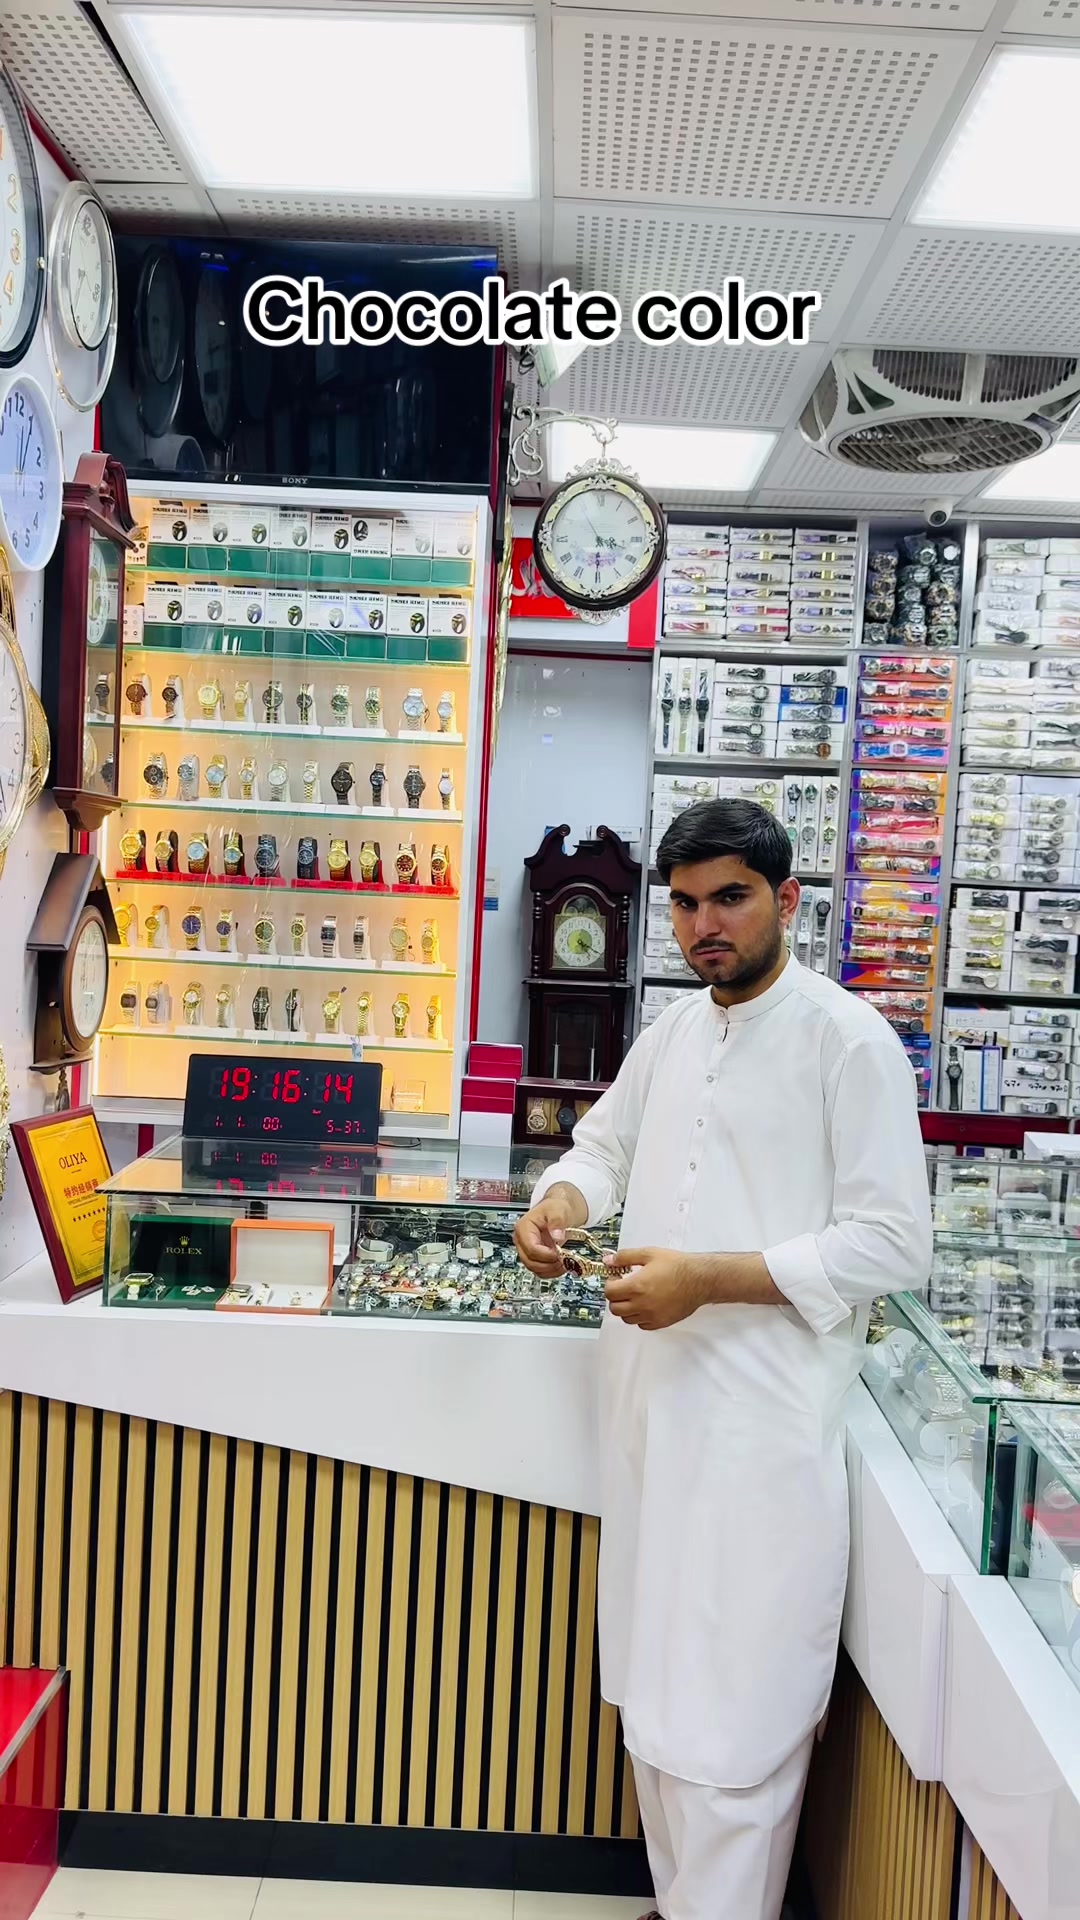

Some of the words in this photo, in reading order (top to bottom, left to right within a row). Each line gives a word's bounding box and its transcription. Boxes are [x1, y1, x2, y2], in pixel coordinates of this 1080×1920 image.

[15, 392, 24, 417] 12
[36, 447, 41, 467] 2
[39, 481, 43, 500] 3
[33, 512, 38, 529] 4
[12, 530, 18, 548] 6
[25, 528, 30, 548] 5
[14, 732, 20, 755] 3
[262, 1116, 280, 1131] 00
[326, 1119, 334, 1133] 5
[344, 1120, 361, 1134] 37
[59, 1152, 88, 1170] OLIYA
[166, 1246, 203, 1255] ROLEX
